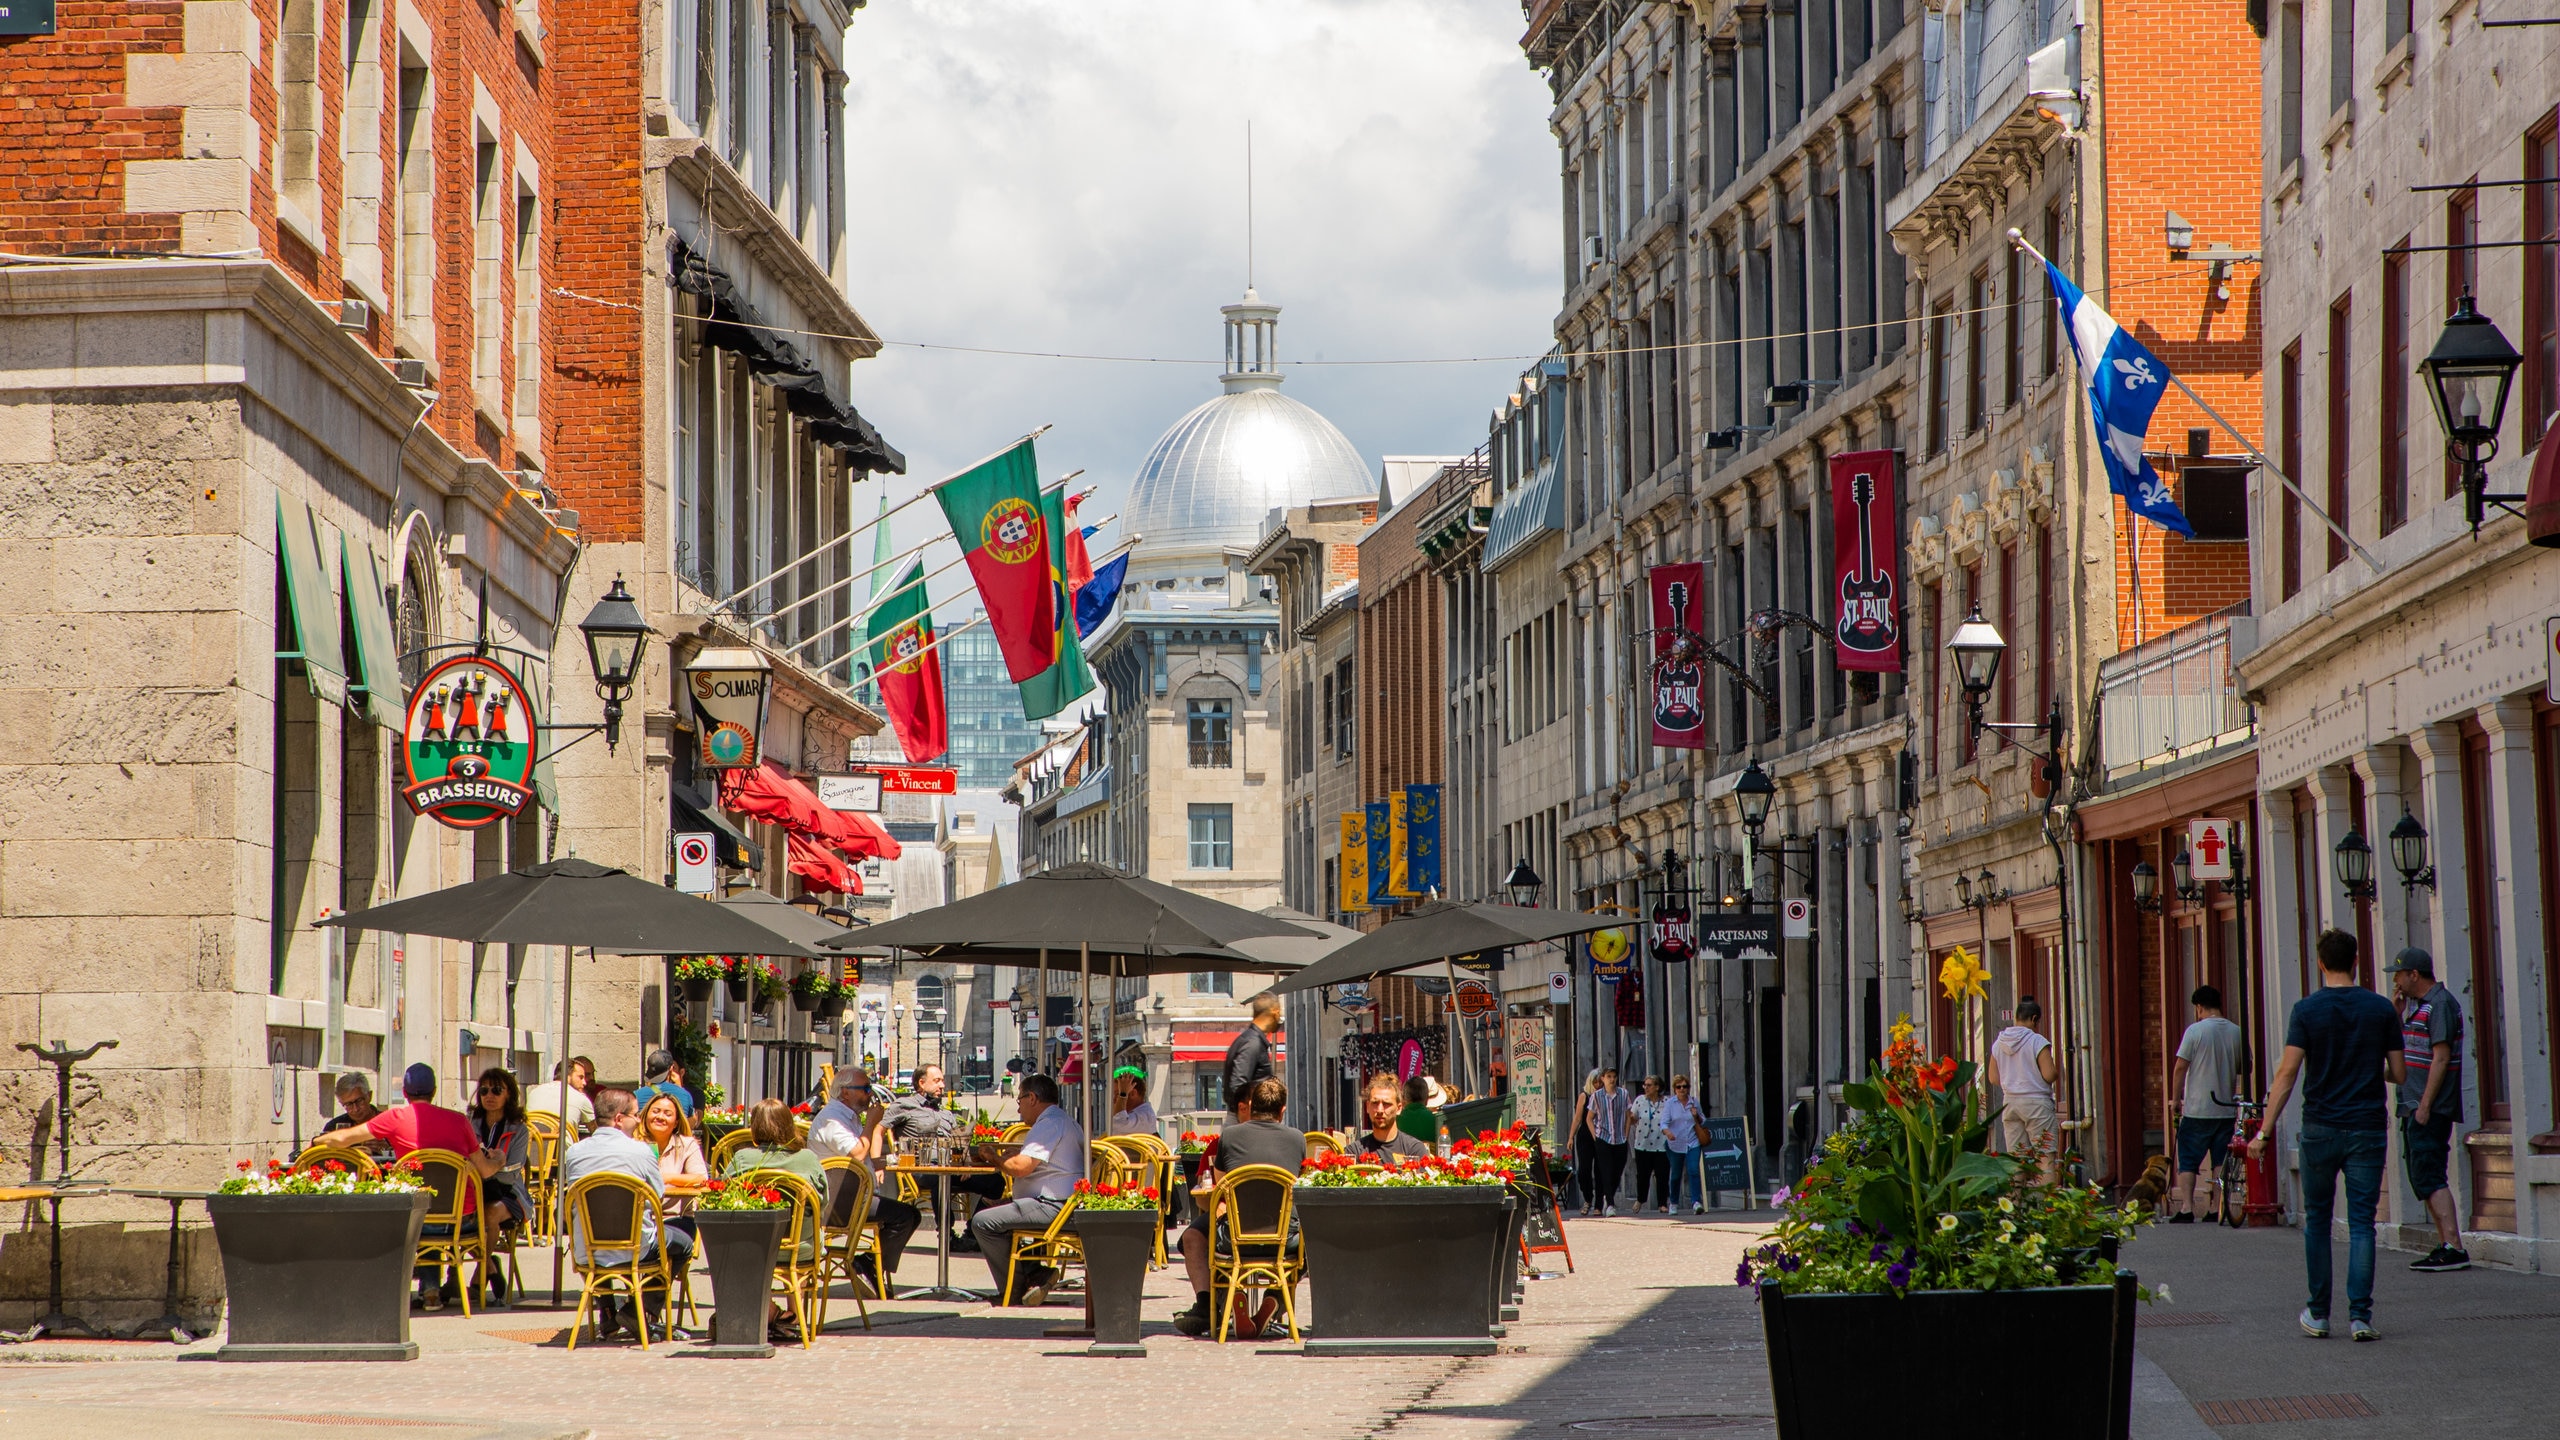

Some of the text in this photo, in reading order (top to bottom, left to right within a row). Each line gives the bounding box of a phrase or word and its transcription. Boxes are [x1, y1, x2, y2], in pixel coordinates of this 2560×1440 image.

[1844, 598, 1892, 634] ST. PAUL
[1659, 686, 1699, 717] ST. PAUL
[459, 744, 482, 753] LES
[463, 760, 476, 777] 3
[884, 778, 942, 790] nt-Vincent
[416, 782, 522, 807] BRASSEURS
[1652, 923, 1692, 949] ST. PAUL
[1708, 930, 1768, 941] ARTISANS
[1593, 963, 1628, 974] Amber
[1525, 1026, 1530, 1039] 3
[1515, 1042, 1541, 1056] BRASSEURS
